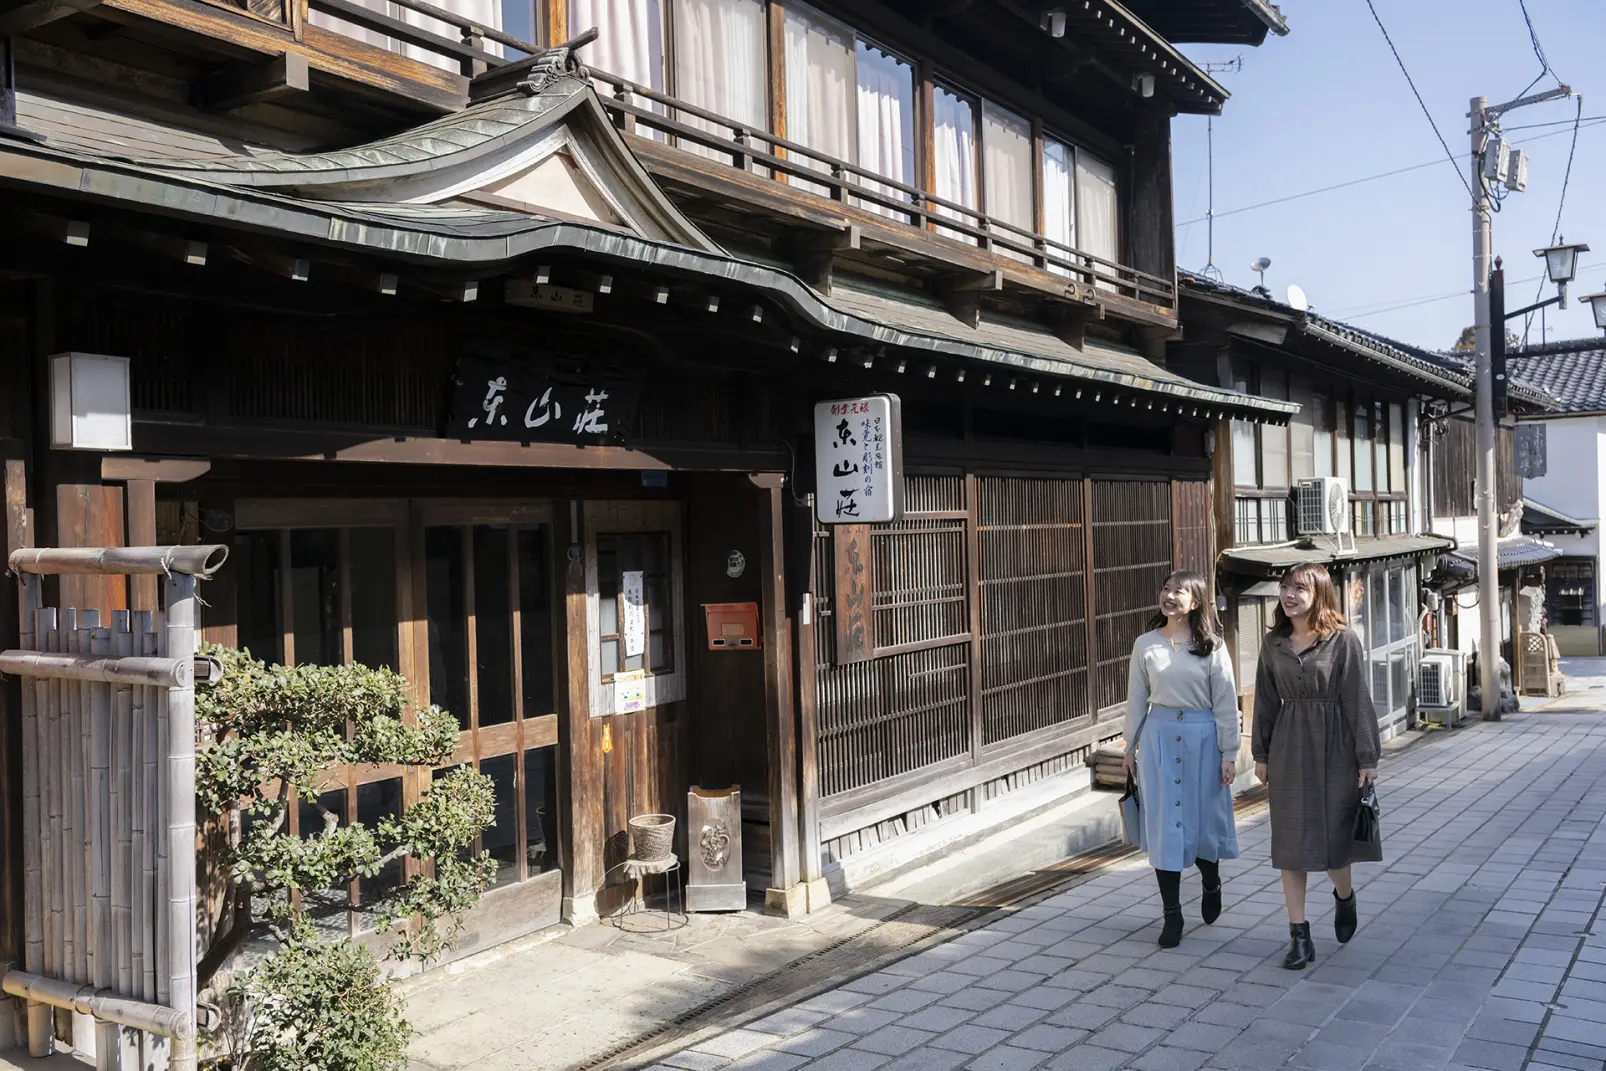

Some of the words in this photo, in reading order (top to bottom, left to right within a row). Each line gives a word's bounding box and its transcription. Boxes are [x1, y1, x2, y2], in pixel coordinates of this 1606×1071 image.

[467, 376, 609, 434] 東山荘
[832, 417, 861, 518] 東山荘
[860, 418, 874, 496] 味覚と彫刻の宿
